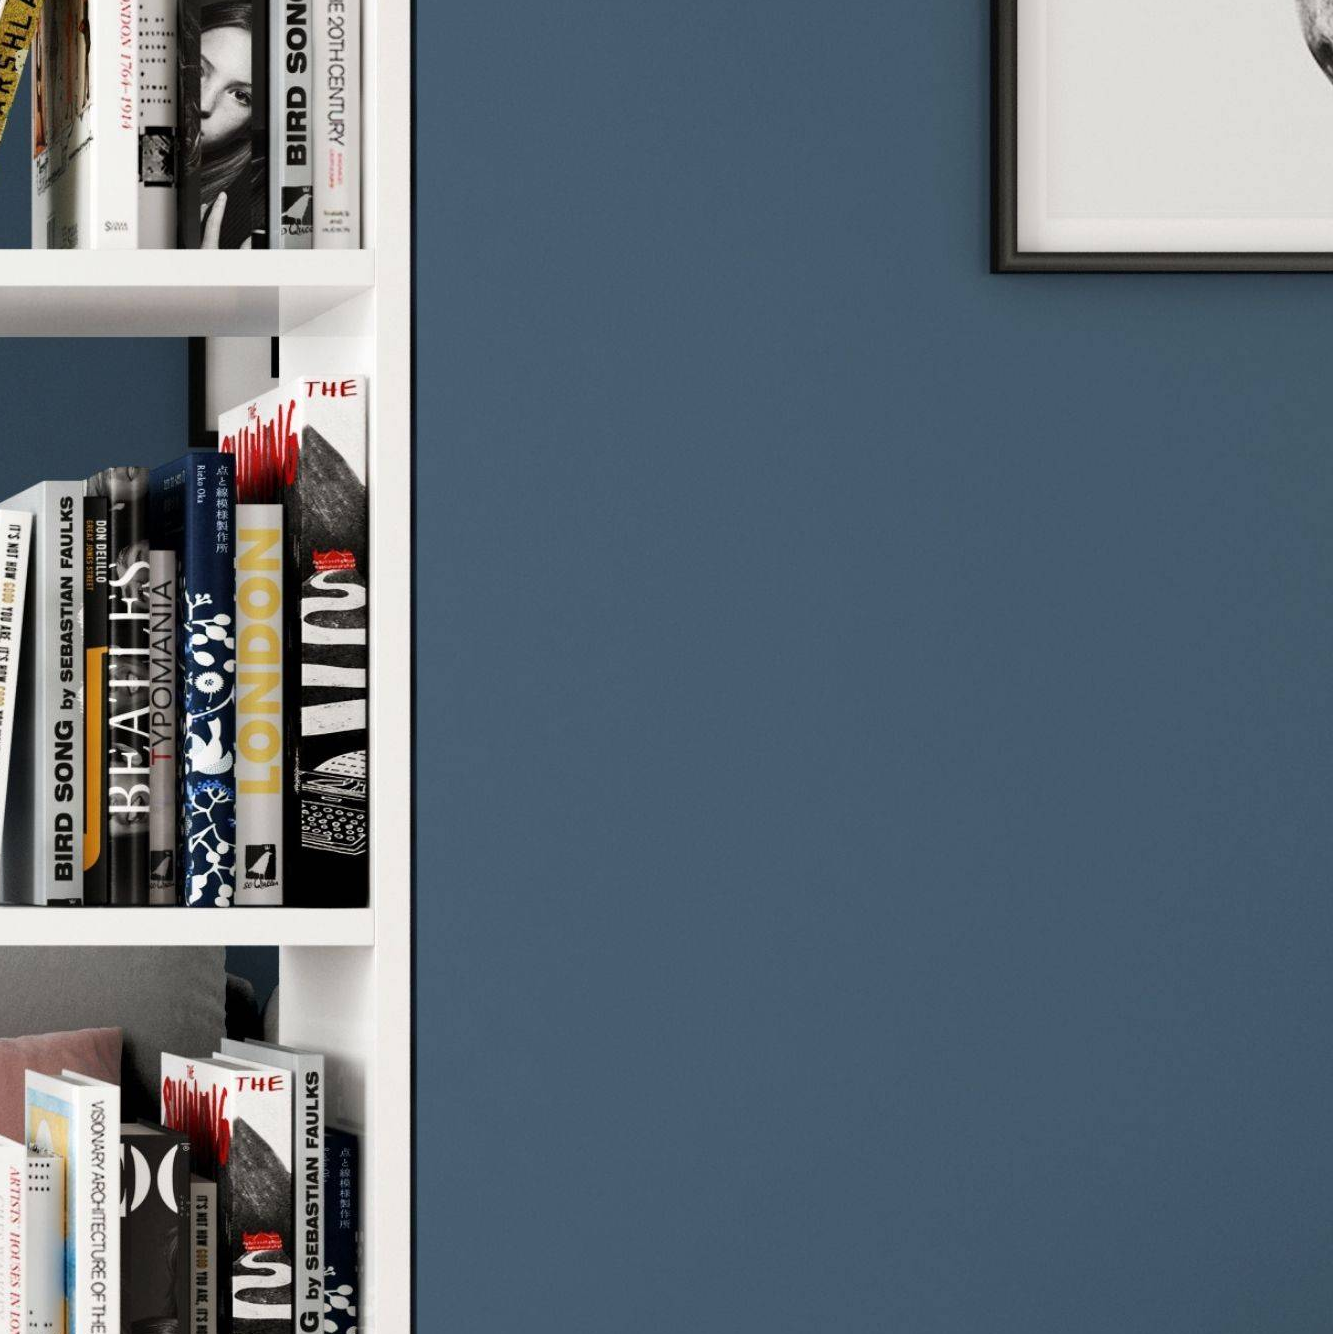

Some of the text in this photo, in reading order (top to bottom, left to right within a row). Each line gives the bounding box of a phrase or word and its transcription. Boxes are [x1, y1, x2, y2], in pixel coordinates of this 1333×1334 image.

[327, 16, 345, 62] 20TH
[327, 63, 345, 147] CENTURY
[286, 86, 307, 165] BIRD
[304, 379, 358, 398] THE
[196, 464, 207, 504] Rieko Oka
[7, 523, 21, 540] IT'S
[85, 519, 94, 541] GREAT
[6, 542, 19, 559] NOT
[95, 519, 108, 583] DON DELILLO
[4, 561, 17, 580] HOW
[1, 581, 15, 604] GOOD
[0, 607, 13, 623] YOU
[151, 580, 174, 766] TYPOMANIA
[238, 528, 282, 795] LONDON
[54, 496, 77, 881] BIRD SONG by SEBASTIAN FAULKS
[236, 1075, 284, 1093] THE
[305, 1071, 319, 1149] FAULKS
[90, 1100, 107, 1170] VISIONARY
[195, 1195, 208, 1210] IT'S
[90, 1172, 107, 1279] ARCHITECTURE
[195, 1212, 208, 1227] NOT
[305, 1158, 320, 1271] SEBASTIAN
[9, 1232, 22, 1288] HOUSES
[195, 1271, 208, 1286] YOU
[305, 1277, 322, 1300] by
[9, 1291, 22, 1308] IN
[90, 1281, 107, 1303] OF
[90, 1305, 107, 1334] THE
[195, 1308, 208, 1323] IT'S
